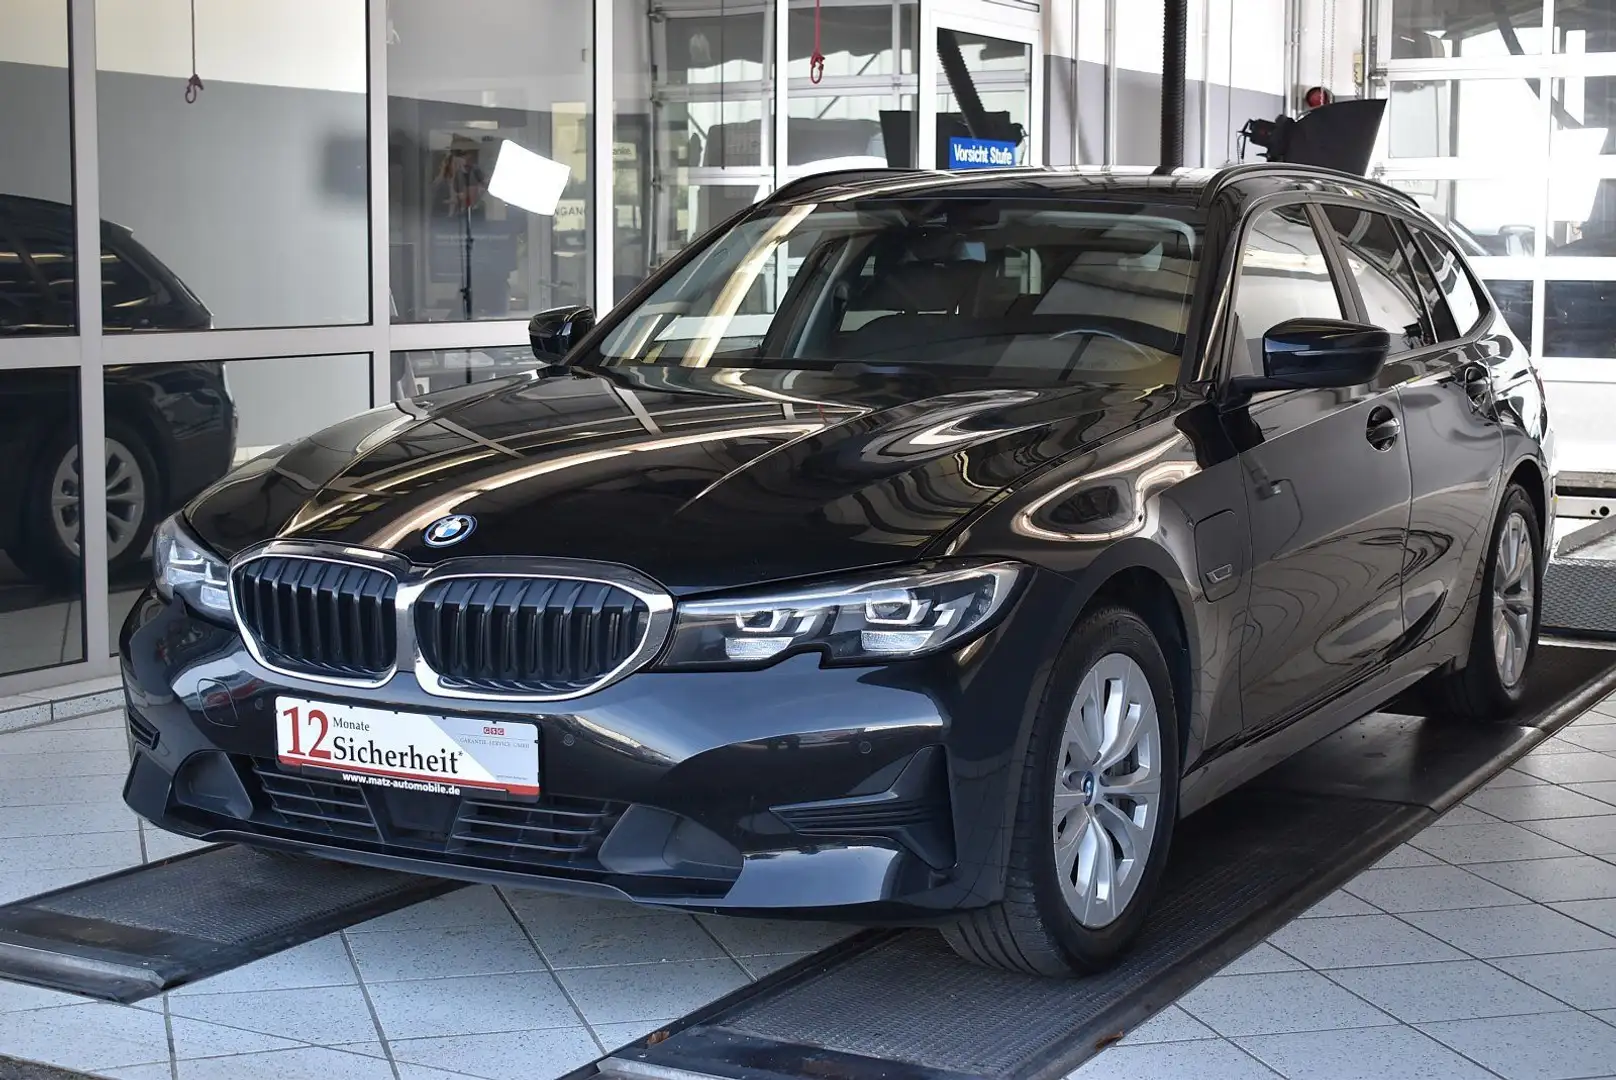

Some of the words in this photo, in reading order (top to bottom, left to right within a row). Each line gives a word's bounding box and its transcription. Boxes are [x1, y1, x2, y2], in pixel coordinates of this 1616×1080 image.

[953, 144, 989, 163] Vorsicht
[990, 146, 1012, 165] Stufe
[283, 706, 331, 760] 12
[333, 717, 370, 731] Monate
[342, 773, 460, 795] www.matz-automobile.de
